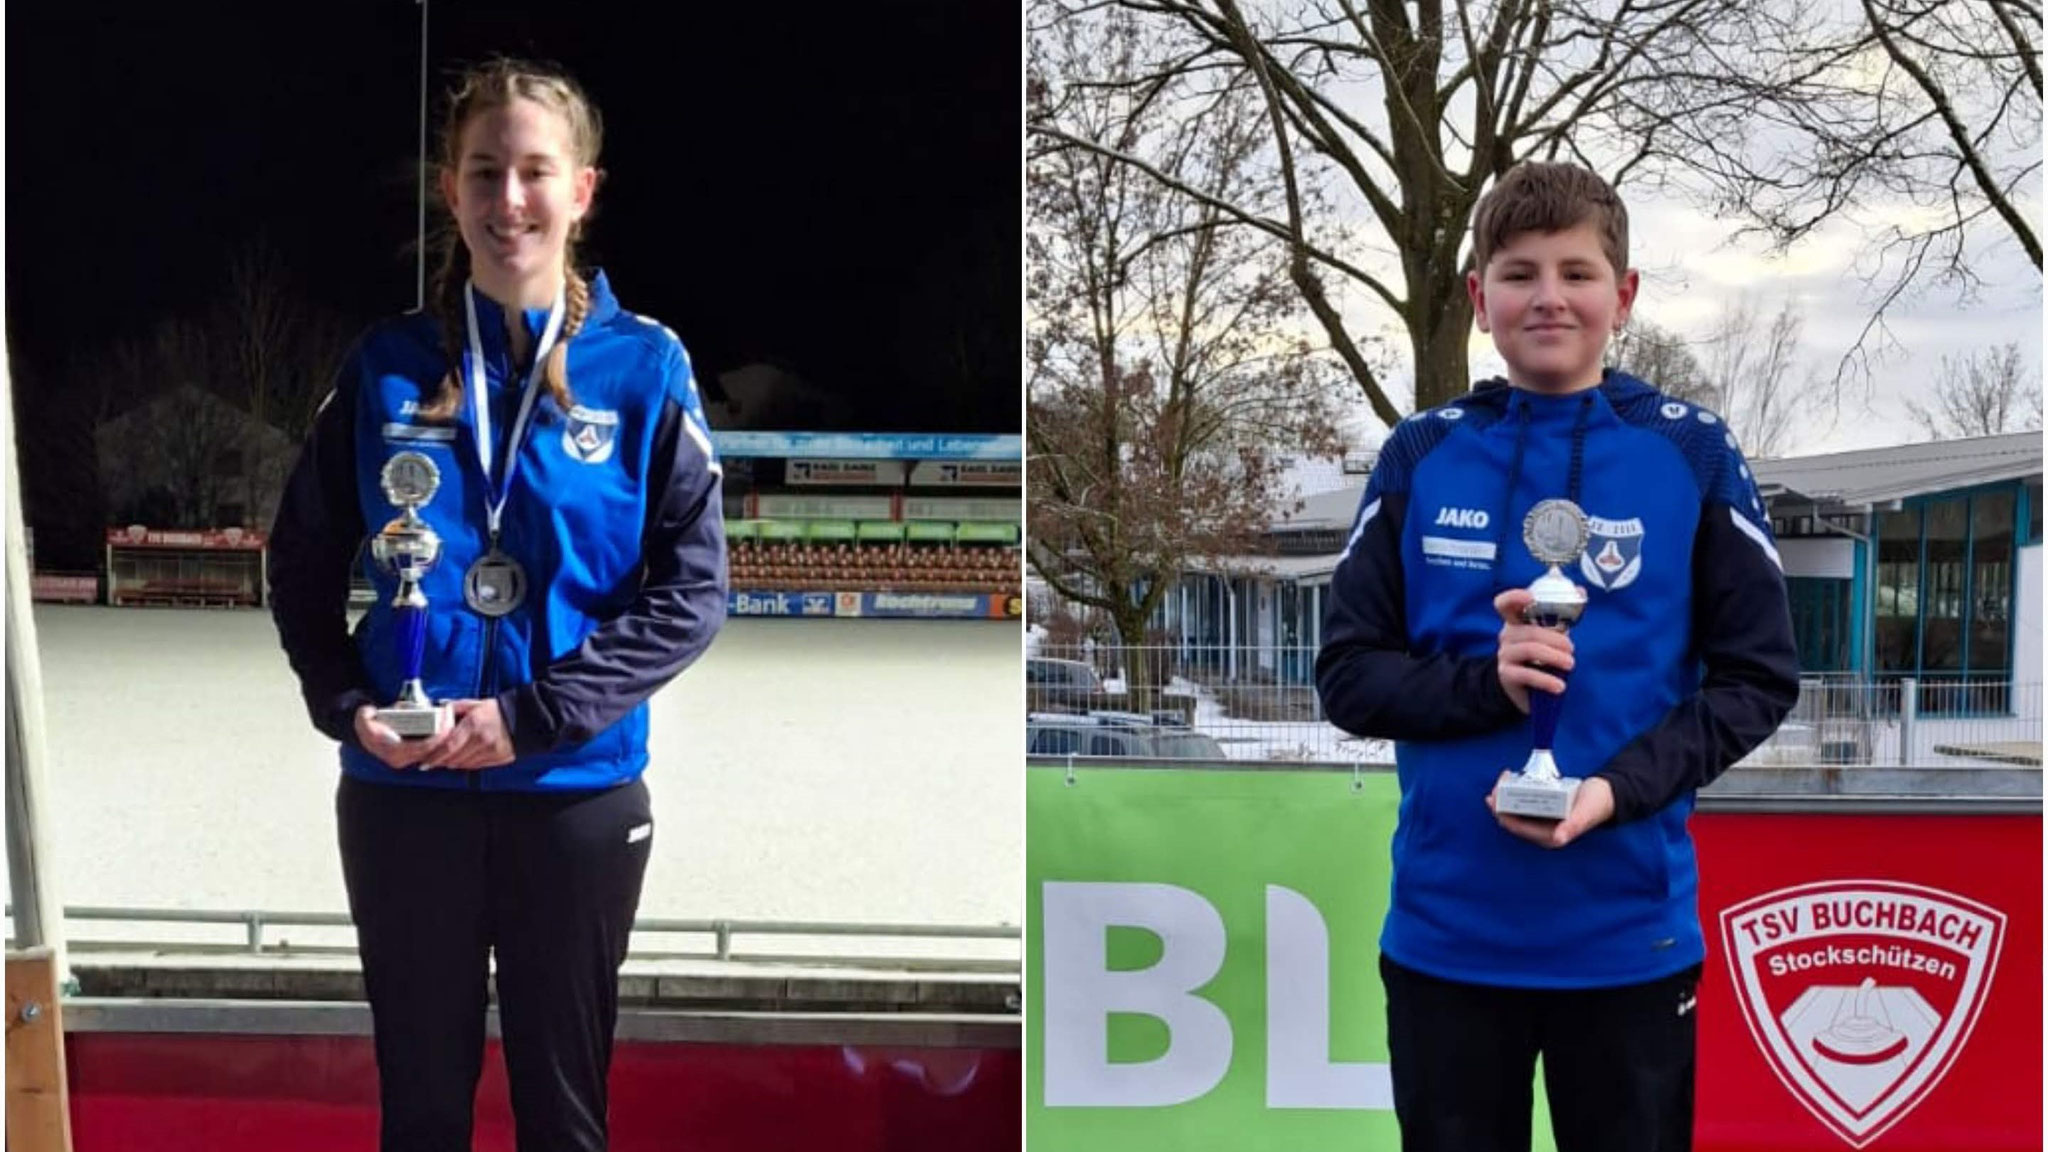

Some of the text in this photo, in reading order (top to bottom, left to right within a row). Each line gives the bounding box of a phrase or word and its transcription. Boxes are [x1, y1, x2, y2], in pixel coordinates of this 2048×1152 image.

[1435, 507, 1490, 529] JAKO
[1740, 900, 1984, 950] TSV BUCHBACH
[1768, 944, 1957, 980] Stockschützen
[1042, 880, 1396, 1109] BL
